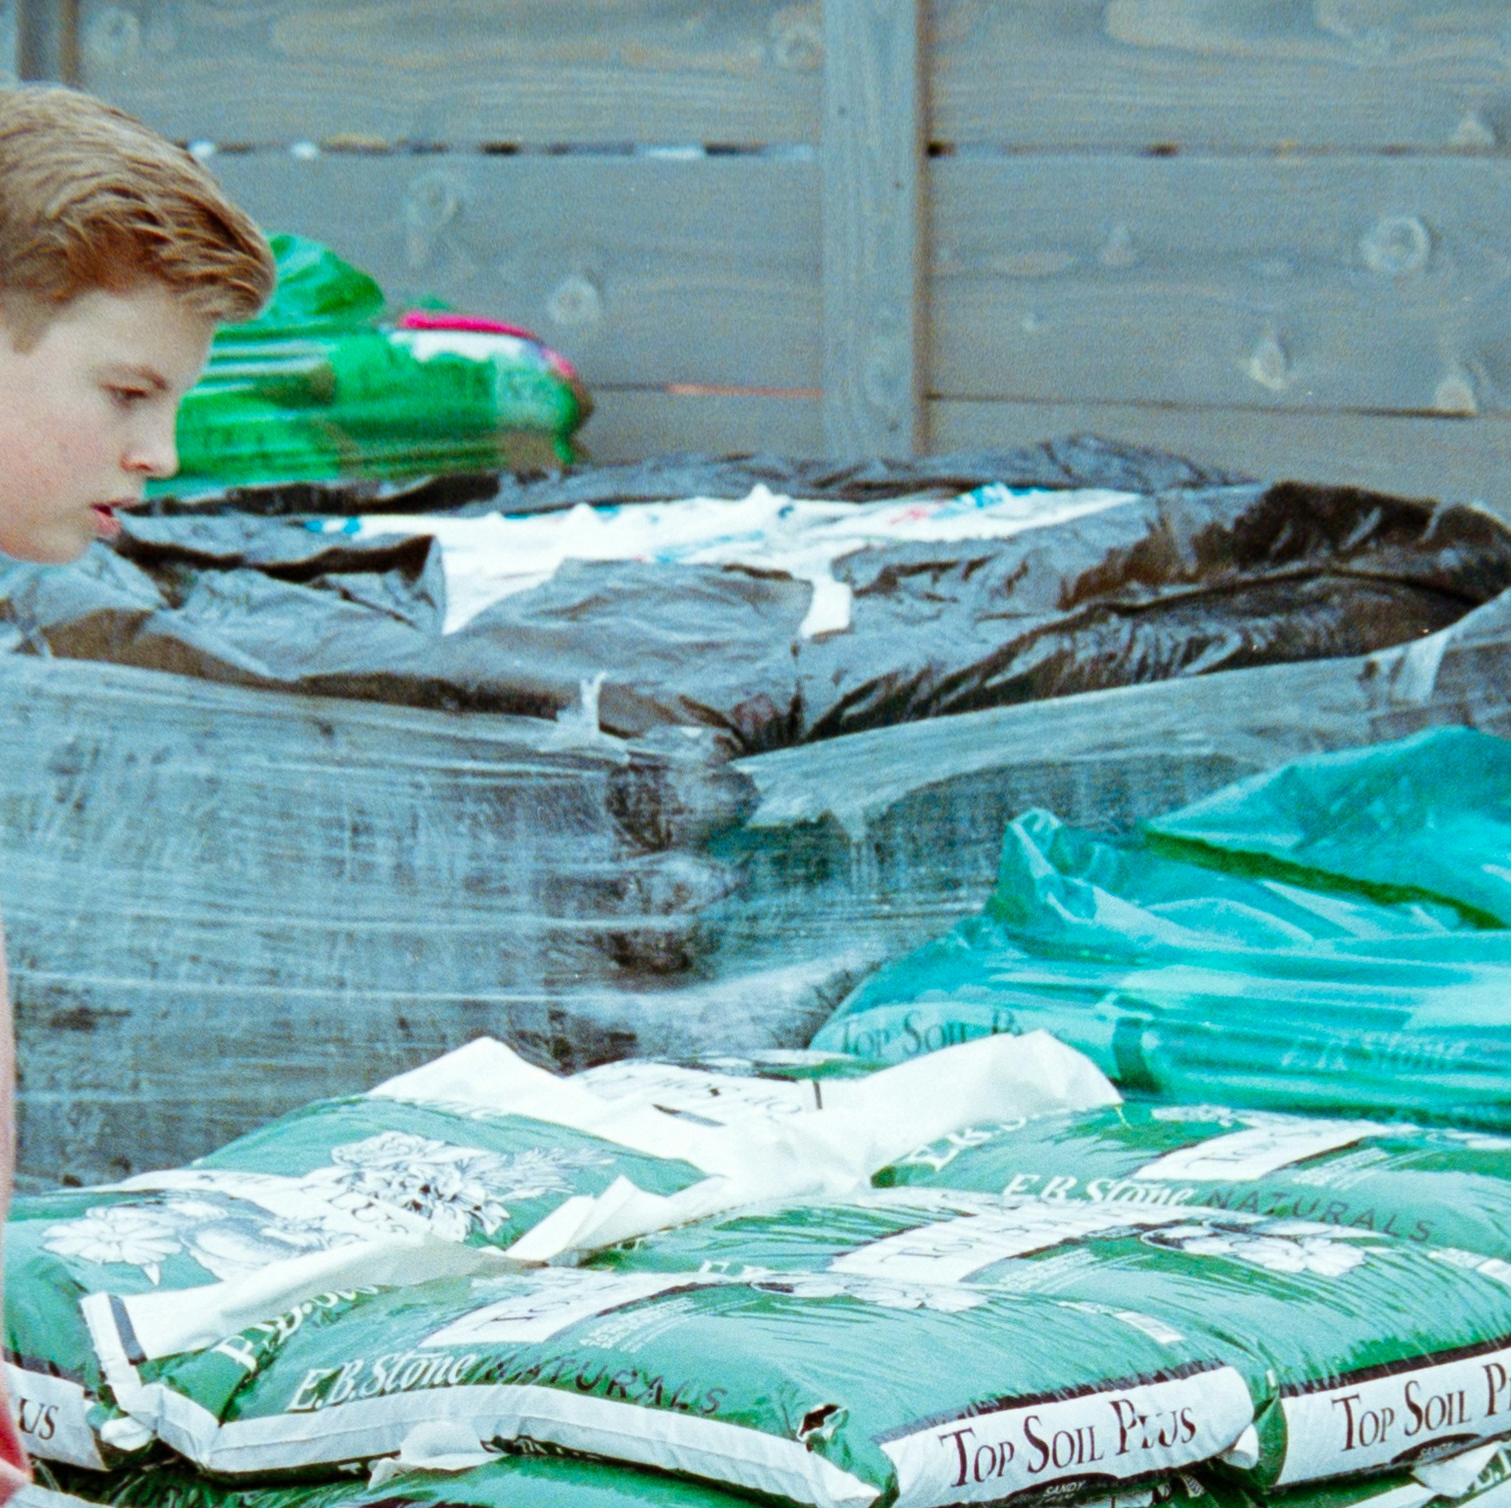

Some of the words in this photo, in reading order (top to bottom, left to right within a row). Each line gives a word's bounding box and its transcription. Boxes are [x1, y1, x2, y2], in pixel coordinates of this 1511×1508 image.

[1205, 1186, 1436, 1243] NATURALS
[483, 1356, 728, 1415] NATURALS
[18, 1399, 59, 1439] US
[939, 1426, 1013, 1487] TOP
[1026, 1415, 1103, 1475] SOIL
[1108, 1398, 1197, 1456] PLUS
[1332, 1395, 1394, 1452] TOP
[1404, 1380, 1467, 1436] SOIL
